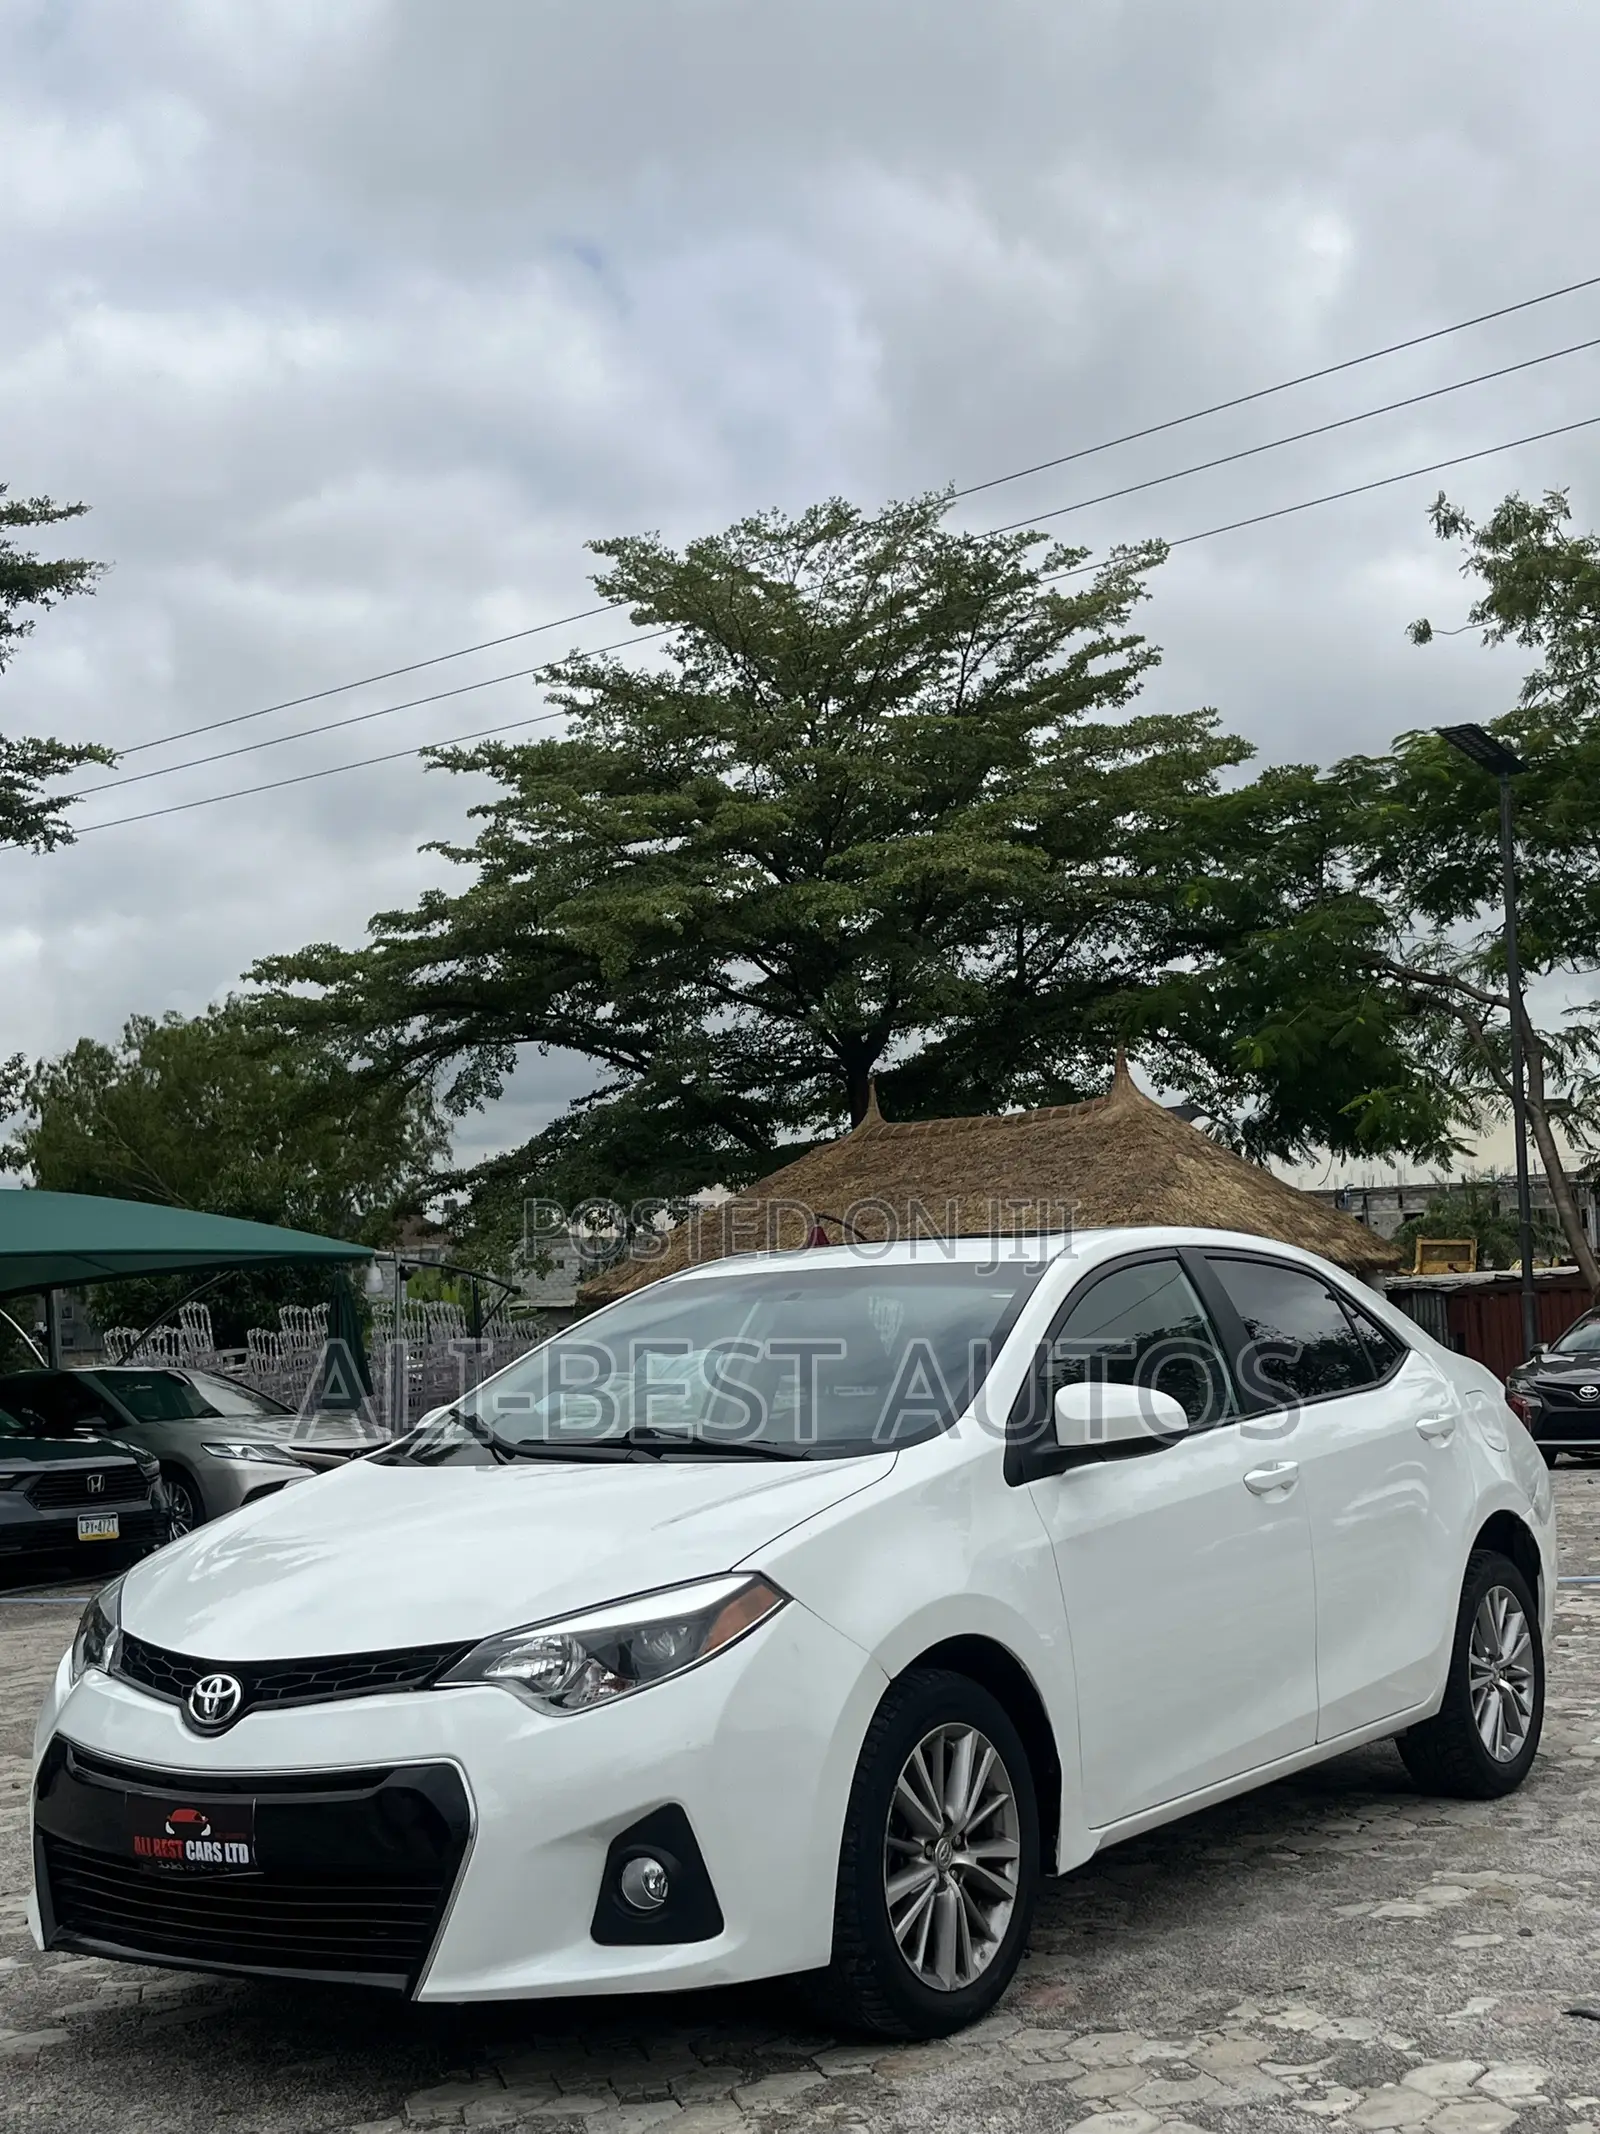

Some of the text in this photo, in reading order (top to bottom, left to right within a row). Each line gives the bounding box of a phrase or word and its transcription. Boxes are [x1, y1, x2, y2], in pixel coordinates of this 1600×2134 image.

[153, 1838, 184, 1860] BEST
[185, 1840, 223, 1862] CARS
[224, 1843, 249, 1864] LTD
